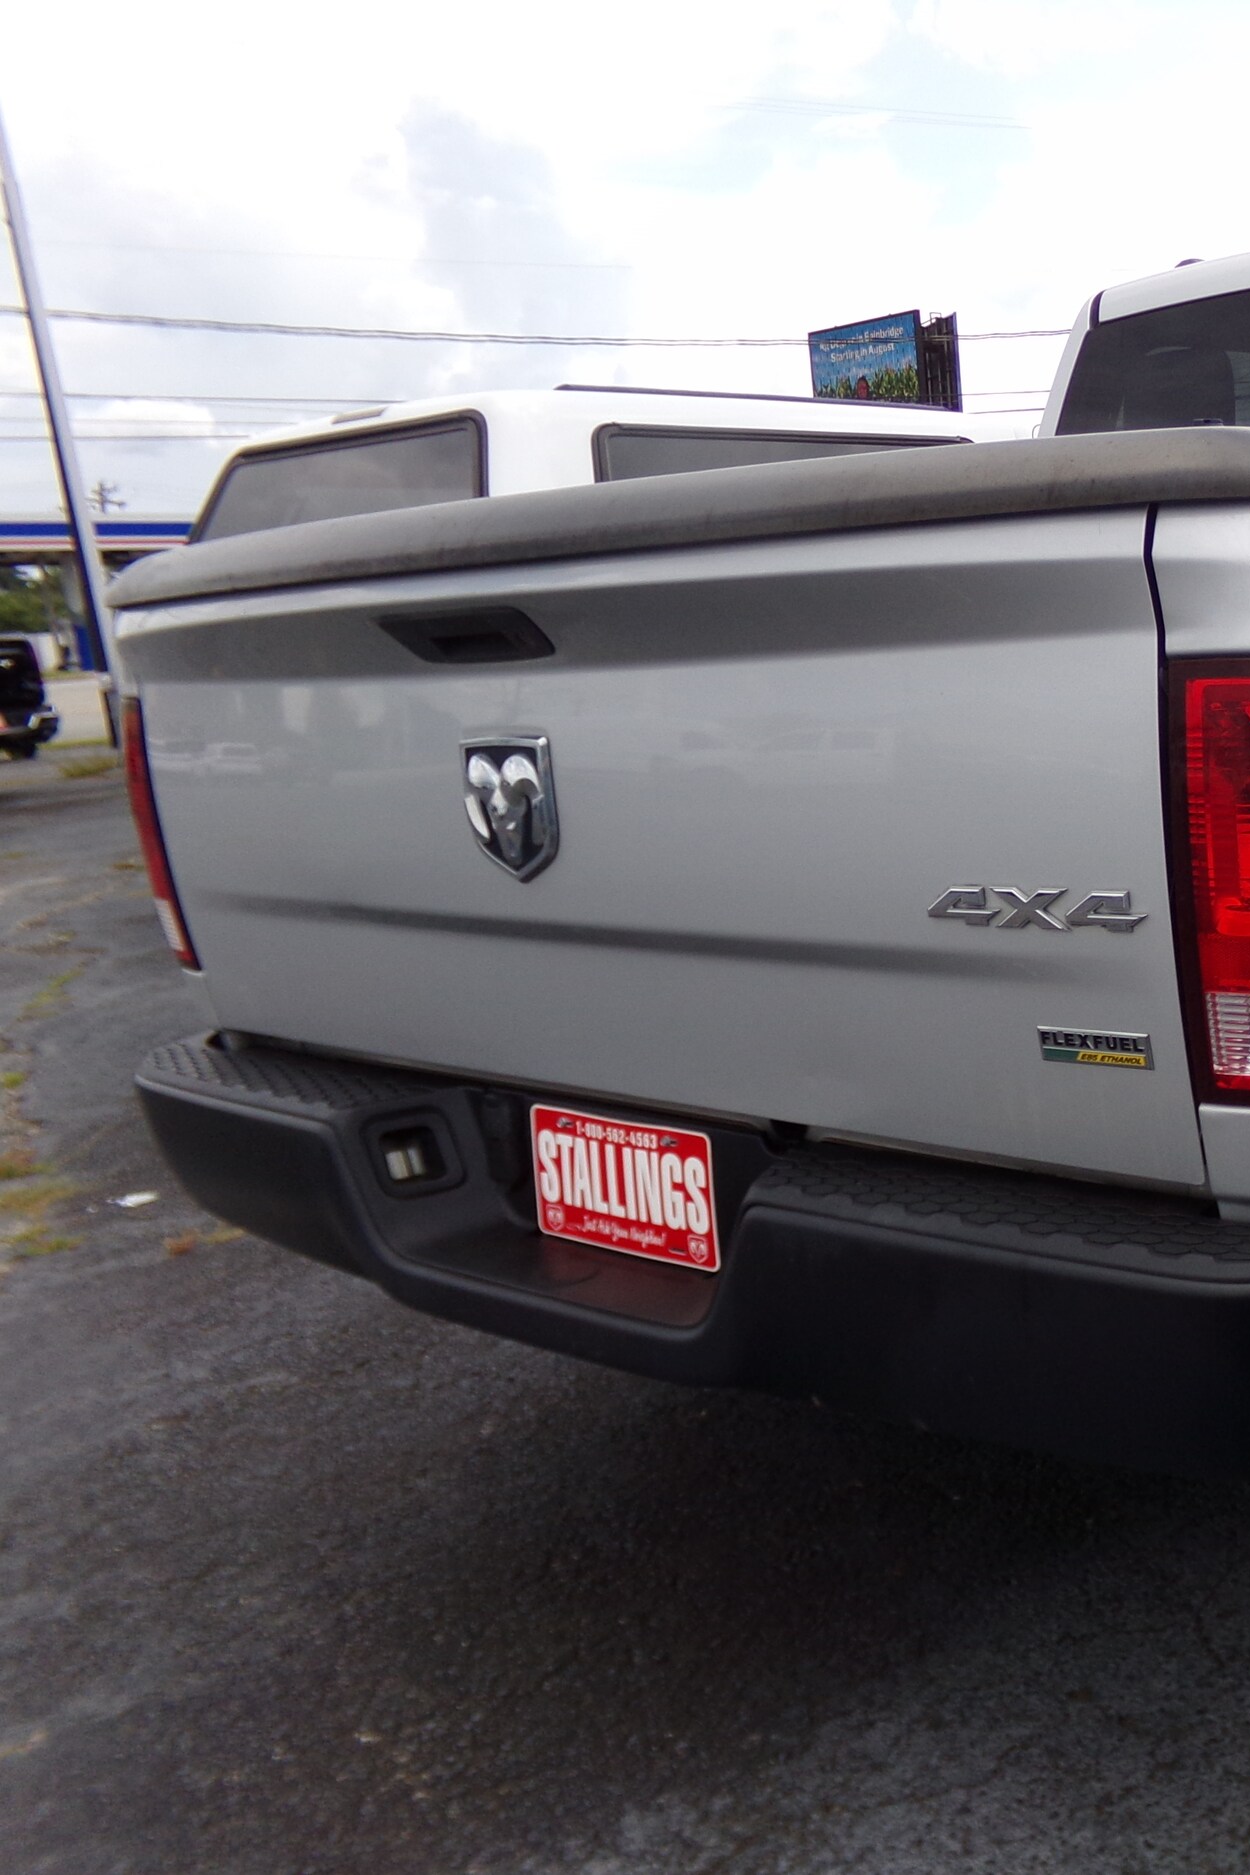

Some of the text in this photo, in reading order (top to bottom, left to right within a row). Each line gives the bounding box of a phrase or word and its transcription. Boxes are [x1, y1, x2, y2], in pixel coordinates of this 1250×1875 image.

[831, 348, 860, 363] Starting
[868, 342, 895, 355] August
[1040, 1030, 1145, 1053] FLEXFUEL
[1080, 1053, 1143, 1066] E85 ETHANOL
[538, 1129, 710, 1235] STALLINGS
